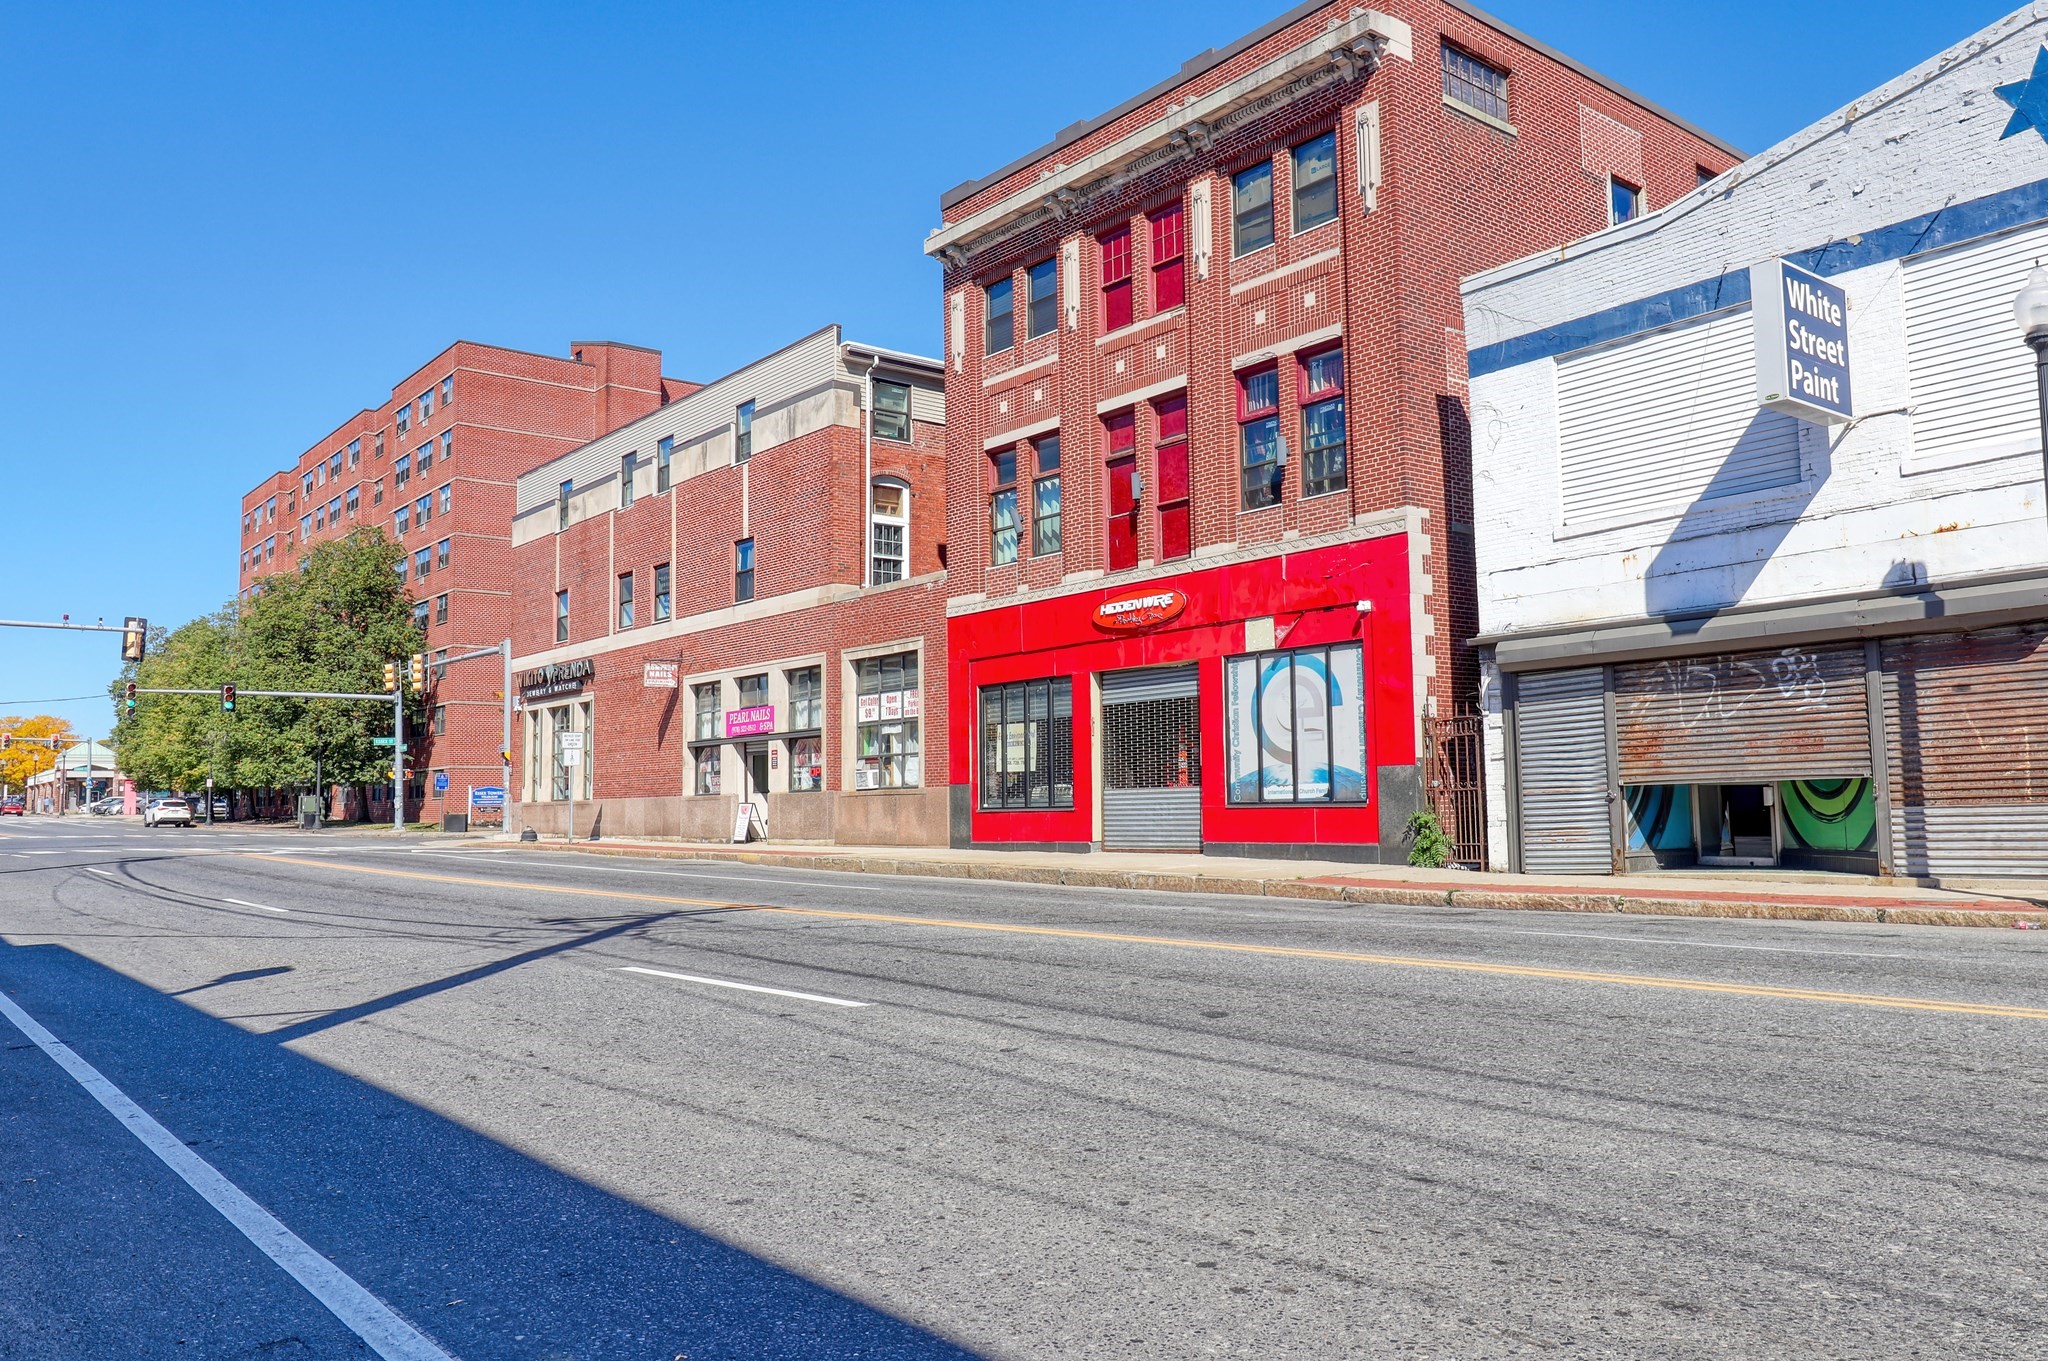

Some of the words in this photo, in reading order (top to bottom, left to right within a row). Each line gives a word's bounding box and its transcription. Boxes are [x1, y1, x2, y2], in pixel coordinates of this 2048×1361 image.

[1786, 277, 1841, 327] White
[1789, 319, 1845, 367] Street
[1791, 359, 1840, 404] Paint
[516, 668, 544, 688] WIKITO
[553, 659, 591, 682] PRENDA
[649, 670, 673, 678] NAILS
[868, 696, 879, 706] Color
[886, 695, 897, 704] Open
[729, 711, 750, 724] PEARL
[750, 708, 771, 721] NAILS
[888, 707, 899, 716] Days
[810, 767, 821, 777] OP
[1233, 749, 1242, 802] Community
